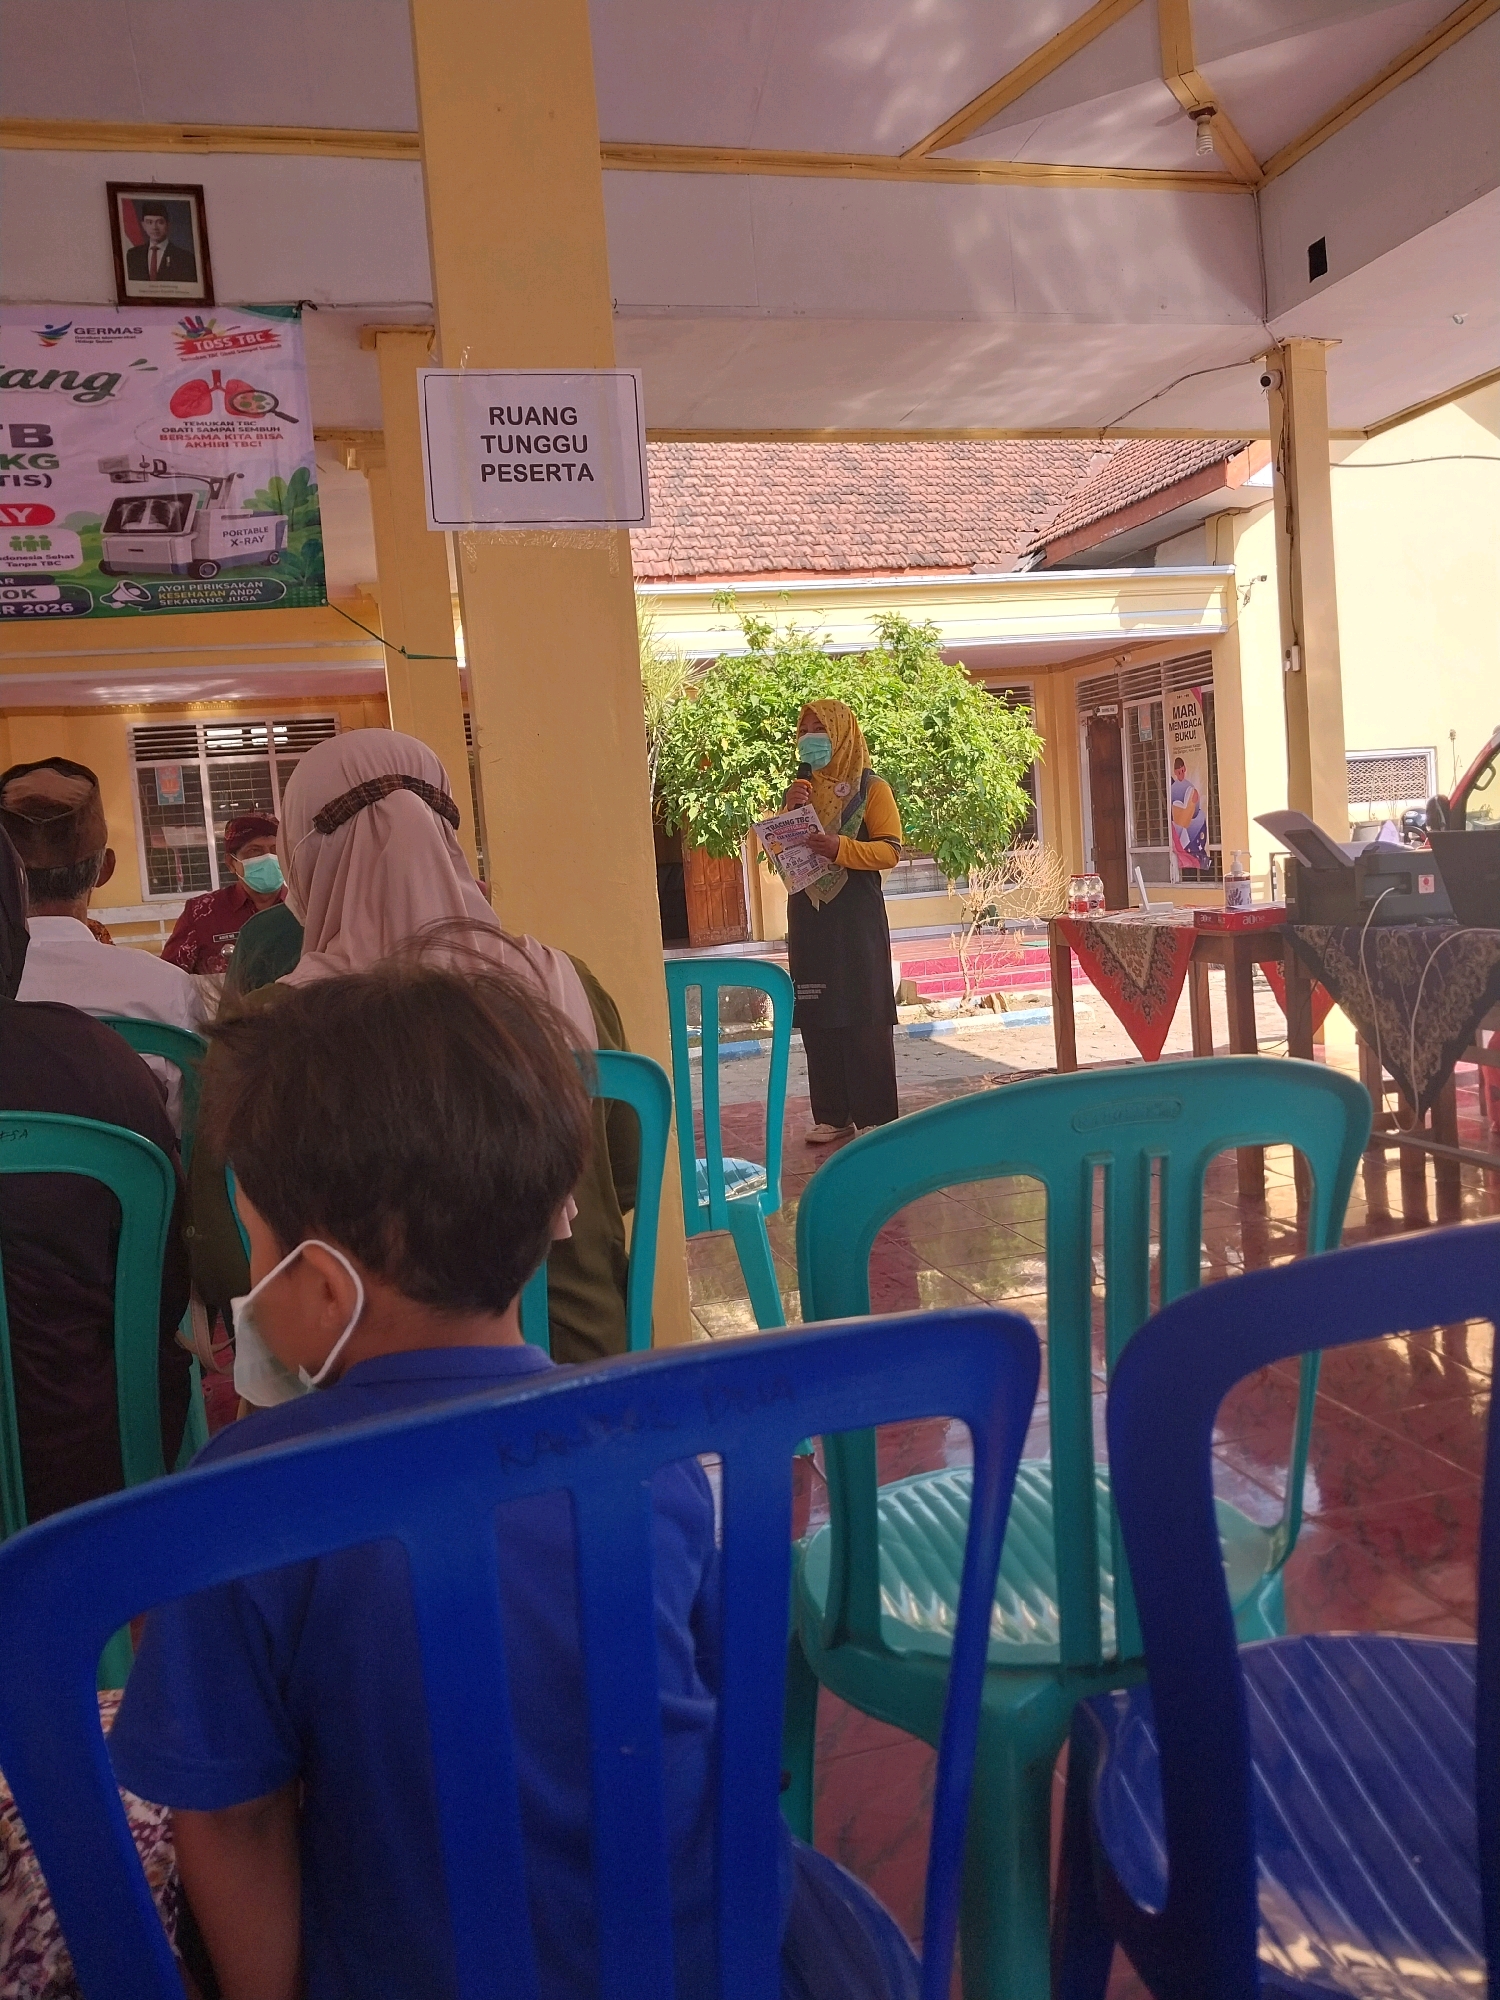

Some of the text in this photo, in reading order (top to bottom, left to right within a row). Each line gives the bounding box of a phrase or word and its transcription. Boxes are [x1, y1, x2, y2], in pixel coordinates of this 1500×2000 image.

[74, 327, 143, 335] GERMAS
[194, 333, 267, 350] TOSS TBC
[0, 364, 122, 402] ang
[488, 406, 578, 426] RUANG
[0, 424, 53, 448] B
[480, 434, 588, 454] TUNGGU
[0, 453, 60, 470] KG
[481, 463, 595, 482] PESERTA
[0, 473, 52, 488] TIS)
[222, 526, 269, 538] PORTABLE
[230, 535, 265, 547] X-RAY
[189, 581, 263, 591] PERIKSAKAN
[0, 588, 37, 599] OK
[158, 590, 226, 599] KESEHATAN
[160, 595, 257, 606] SEKARANG JUGA
[0, 603, 74, 614] R 2026
[1172, 703, 1197, 719] MARI
[1169, 718, 1202, 731] MEMBACA
[1175, 730, 1196, 742] BUKU!
[766, 818, 795, 832] TRACING
[795, 816, 810, 824] TBC
